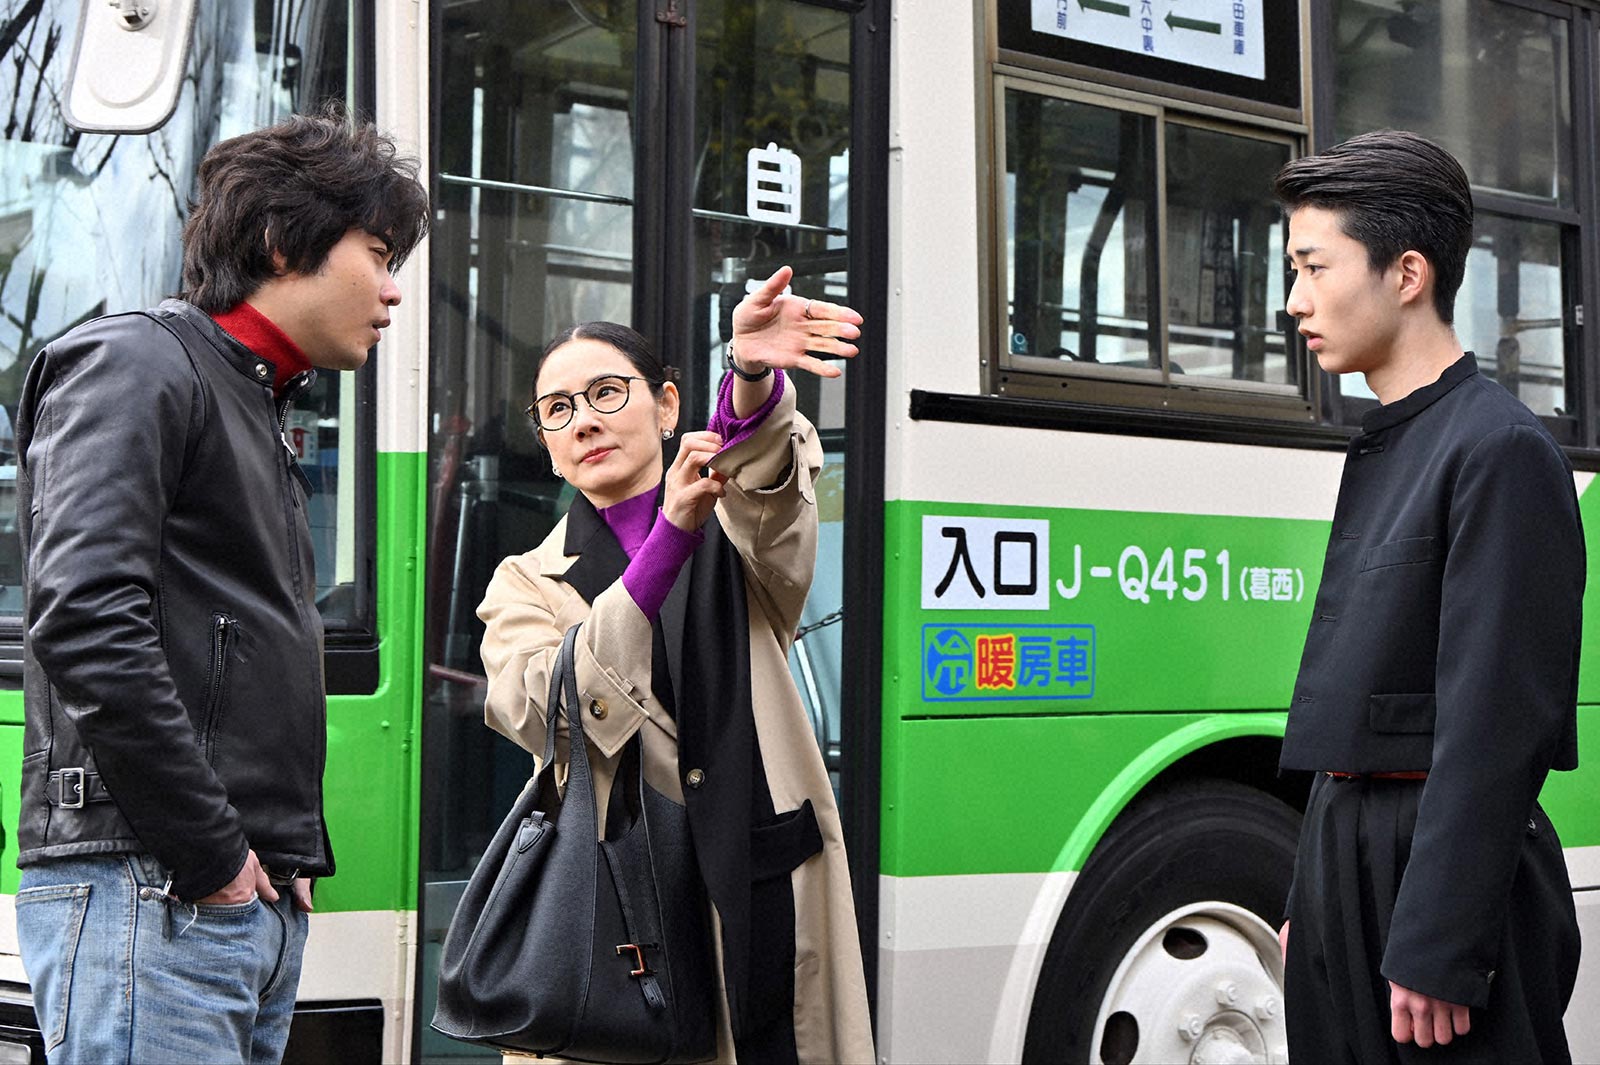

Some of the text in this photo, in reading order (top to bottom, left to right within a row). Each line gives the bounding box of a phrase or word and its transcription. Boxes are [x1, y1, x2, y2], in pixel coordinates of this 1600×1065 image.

[1233, 0, 1245, 55] 田車庫
[935, 527, 1037, 598] 入口
[927, 629, 1089, 695] 冷暖房車
